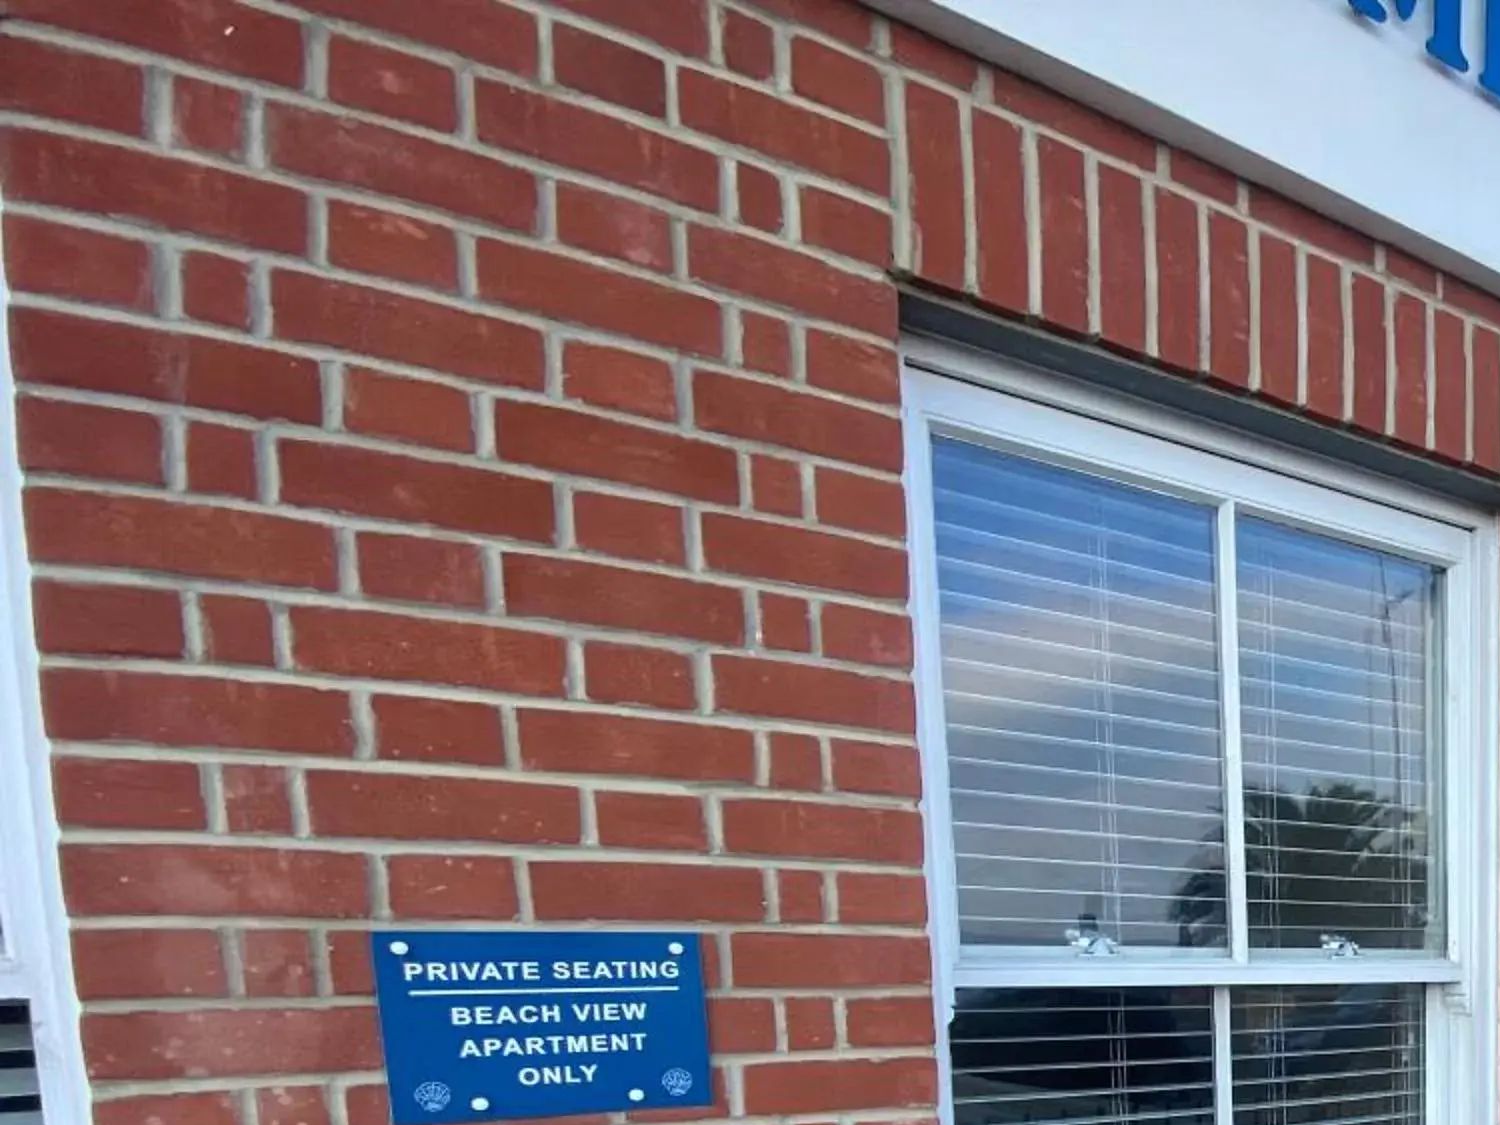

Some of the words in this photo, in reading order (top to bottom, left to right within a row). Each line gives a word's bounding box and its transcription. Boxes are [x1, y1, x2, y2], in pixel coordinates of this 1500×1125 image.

[404, 961, 541, 981] PRIVATE
[551, 960, 680, 980] SEATING
[450, 1004, 561, 1025] BEACH
[572, 1002, 648, 1022] VIEW
[459, 1033, 648, 1058] APARTMENT
[518, 1064, 599, 1086] ONLY
